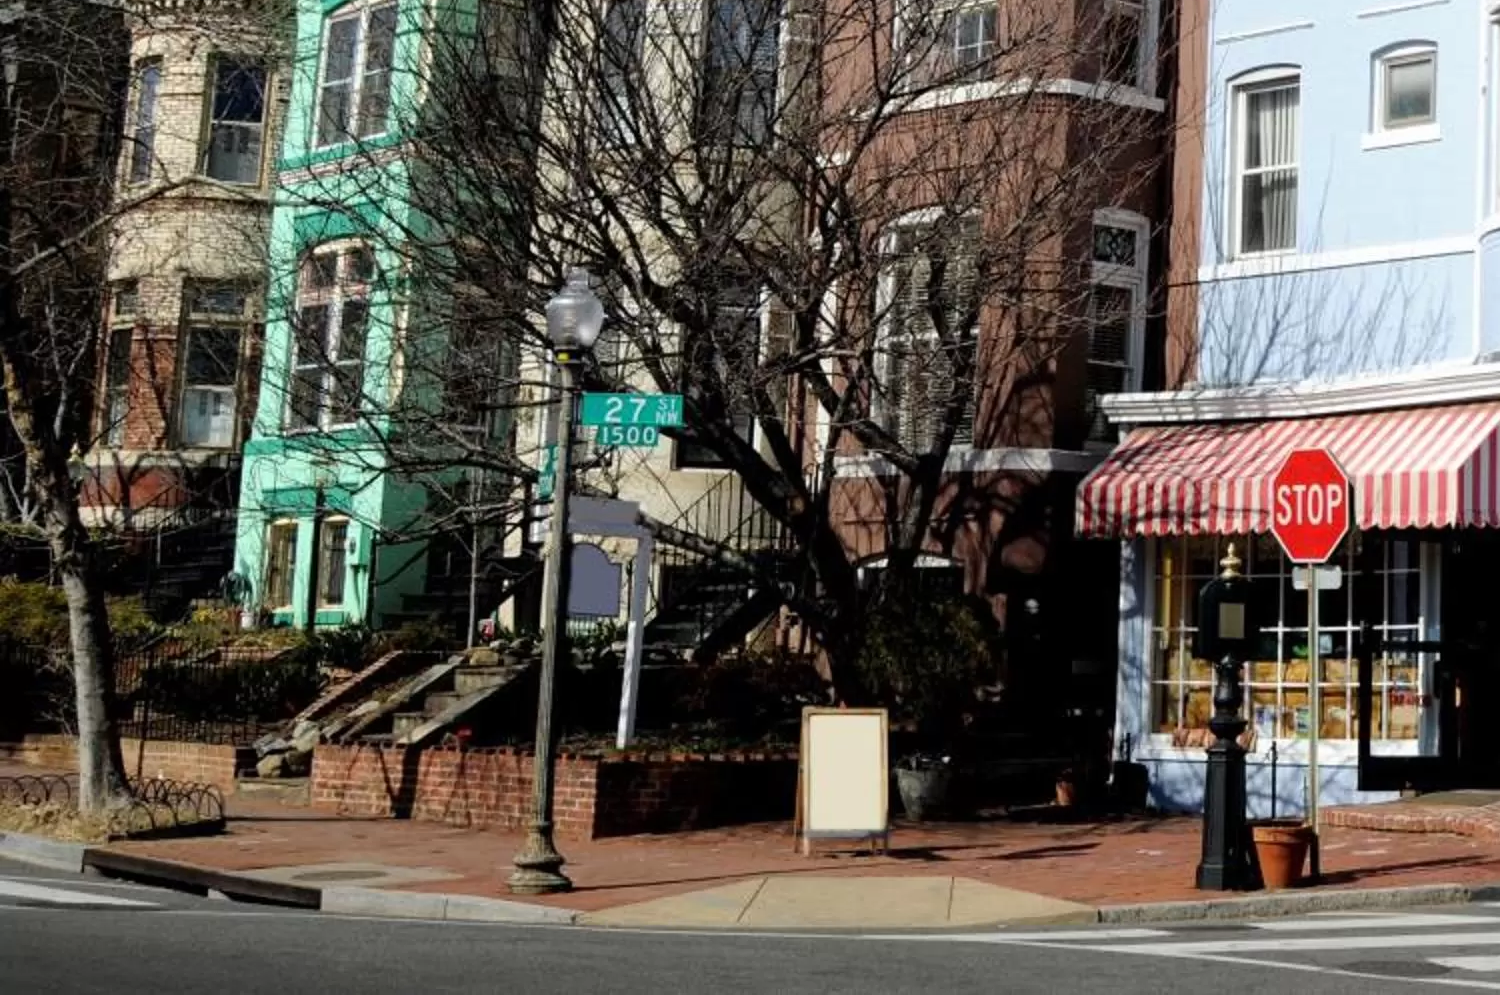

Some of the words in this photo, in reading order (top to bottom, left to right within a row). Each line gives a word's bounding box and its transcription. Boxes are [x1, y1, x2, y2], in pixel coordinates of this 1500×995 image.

[604, 396, 647, 424] 27
[657, 397, 677, 410] ST
[655, 410, 678, 425] NW
[602, 426, 657, 444] 1500
[1276, 482, 1343, 526] STOP
